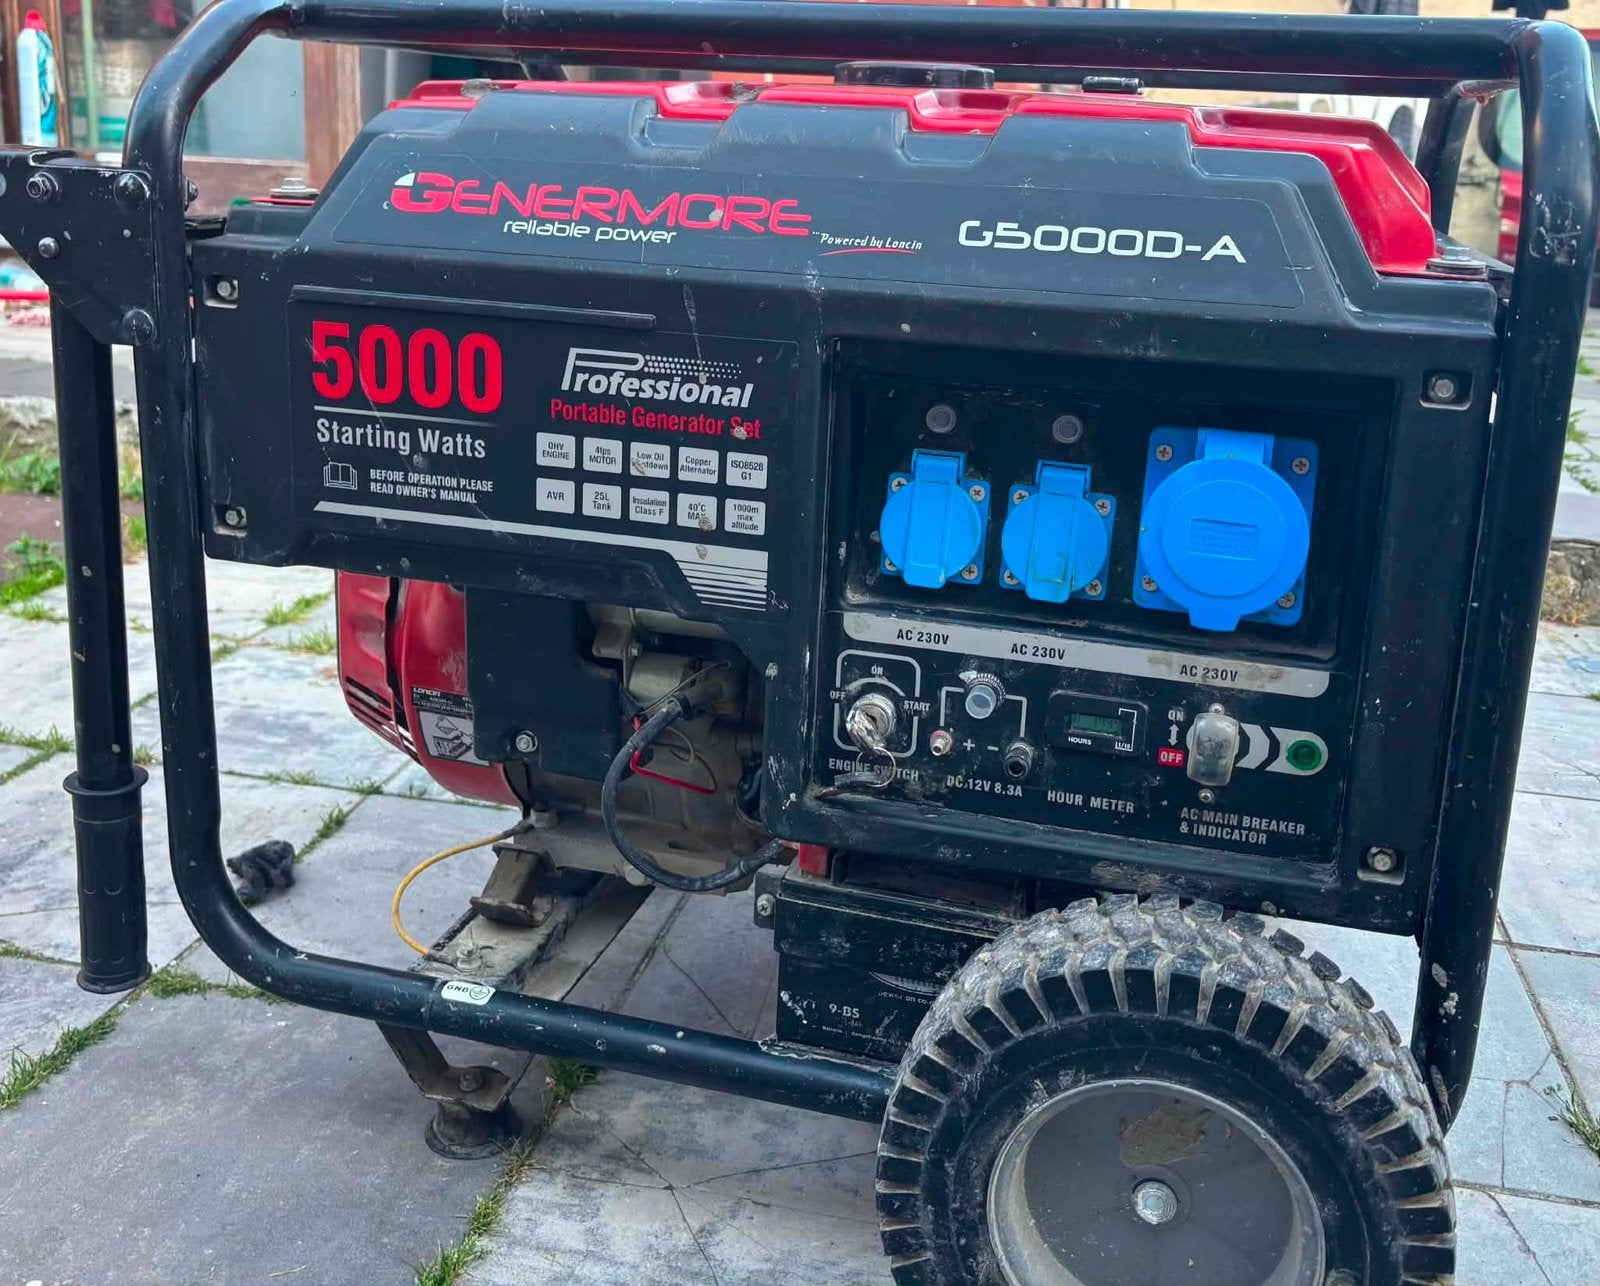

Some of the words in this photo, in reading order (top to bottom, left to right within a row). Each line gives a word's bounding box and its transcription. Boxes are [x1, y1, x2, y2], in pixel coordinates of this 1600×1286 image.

[391, 172, 812, 237] GENERMORE
[594, 226, 678, 245] power
[958, 220, 1247, 263] G5000D-A
[869, 235, 884, 249] by
[885, 237, 922, 250] Loncin
[312, 320, 503, 414] 5000
[560, 346, 754, 408] Professional
[550, 398, 627, 426] Portable
[632, 406, 724, 436] Generator
[730, 415, 761, 439] Set
[316, 418, 410, 455] Starting
[417, 427, 486, 459] Watts
[542, 449, 570, 461] ENGINE
[589, 454, 617, 466] MOTOR
[636, 450, 652, 460] Low
[654, 452, 664, 462] Oil
[685, 455, 711, 467] Copper
[680, 464, 717, 476] Alternator
[731, 459, 764, 472] ISO8528
[370, 468, 405, 482] BEFORE
[407, 472, 457, 488] OPERATION
[460, 478, 493, 492] PLEASE
[741, 471, 752, 481] G1
[370, 482, 393, 494] READ
[396, 484, 436, 499] OWNER'S
[440, 489, 477, 503] MANUAL
[546, 490, 565, 501] AVR
[594, 490, 609, 501] 25L
[592, 500, 612, 511] Tank
[632, 496, 667, 508] Insulation
[733, 503, 759, 514] 1000m
[634, 506, 657, 517] Class
[658, 508, 664, 517] F
[896, 628, 913, 641] AC
[916, 631, 949, 646] 230V
[1010, 643, 1027, 656] AC
[1032, 646, 1065, 660] 230V
[871, 664, 884, 676] ON
[1179, 664, 1198, 677] AC
[1202, 667, 1239, 682] 230V
[829, 690, 846, 701] OFF
[903, 700, 930, 712] START
[1167, 709, 1184, 722] ON
[1068, 735, 1092, 746] HOURS
[1160, 751, 1183, 763] OFF
[828, 758, 870, 773] ENGINE
[994, 782, 1023, 798] 8.3A
[1047, 789, 1083, 806] HOUR
[1089, 796, 1135, 813] METER
[1180, 806, 1199, 820] AC
[1202, 809, 1238, 826] MAIN
[1242, 815, 1306, 835] BREAKER
[1179, 821, 1189, 834] &
[1193, 823, 1267, 845] INDICATOR
[446, 984, 469, 993] GND
